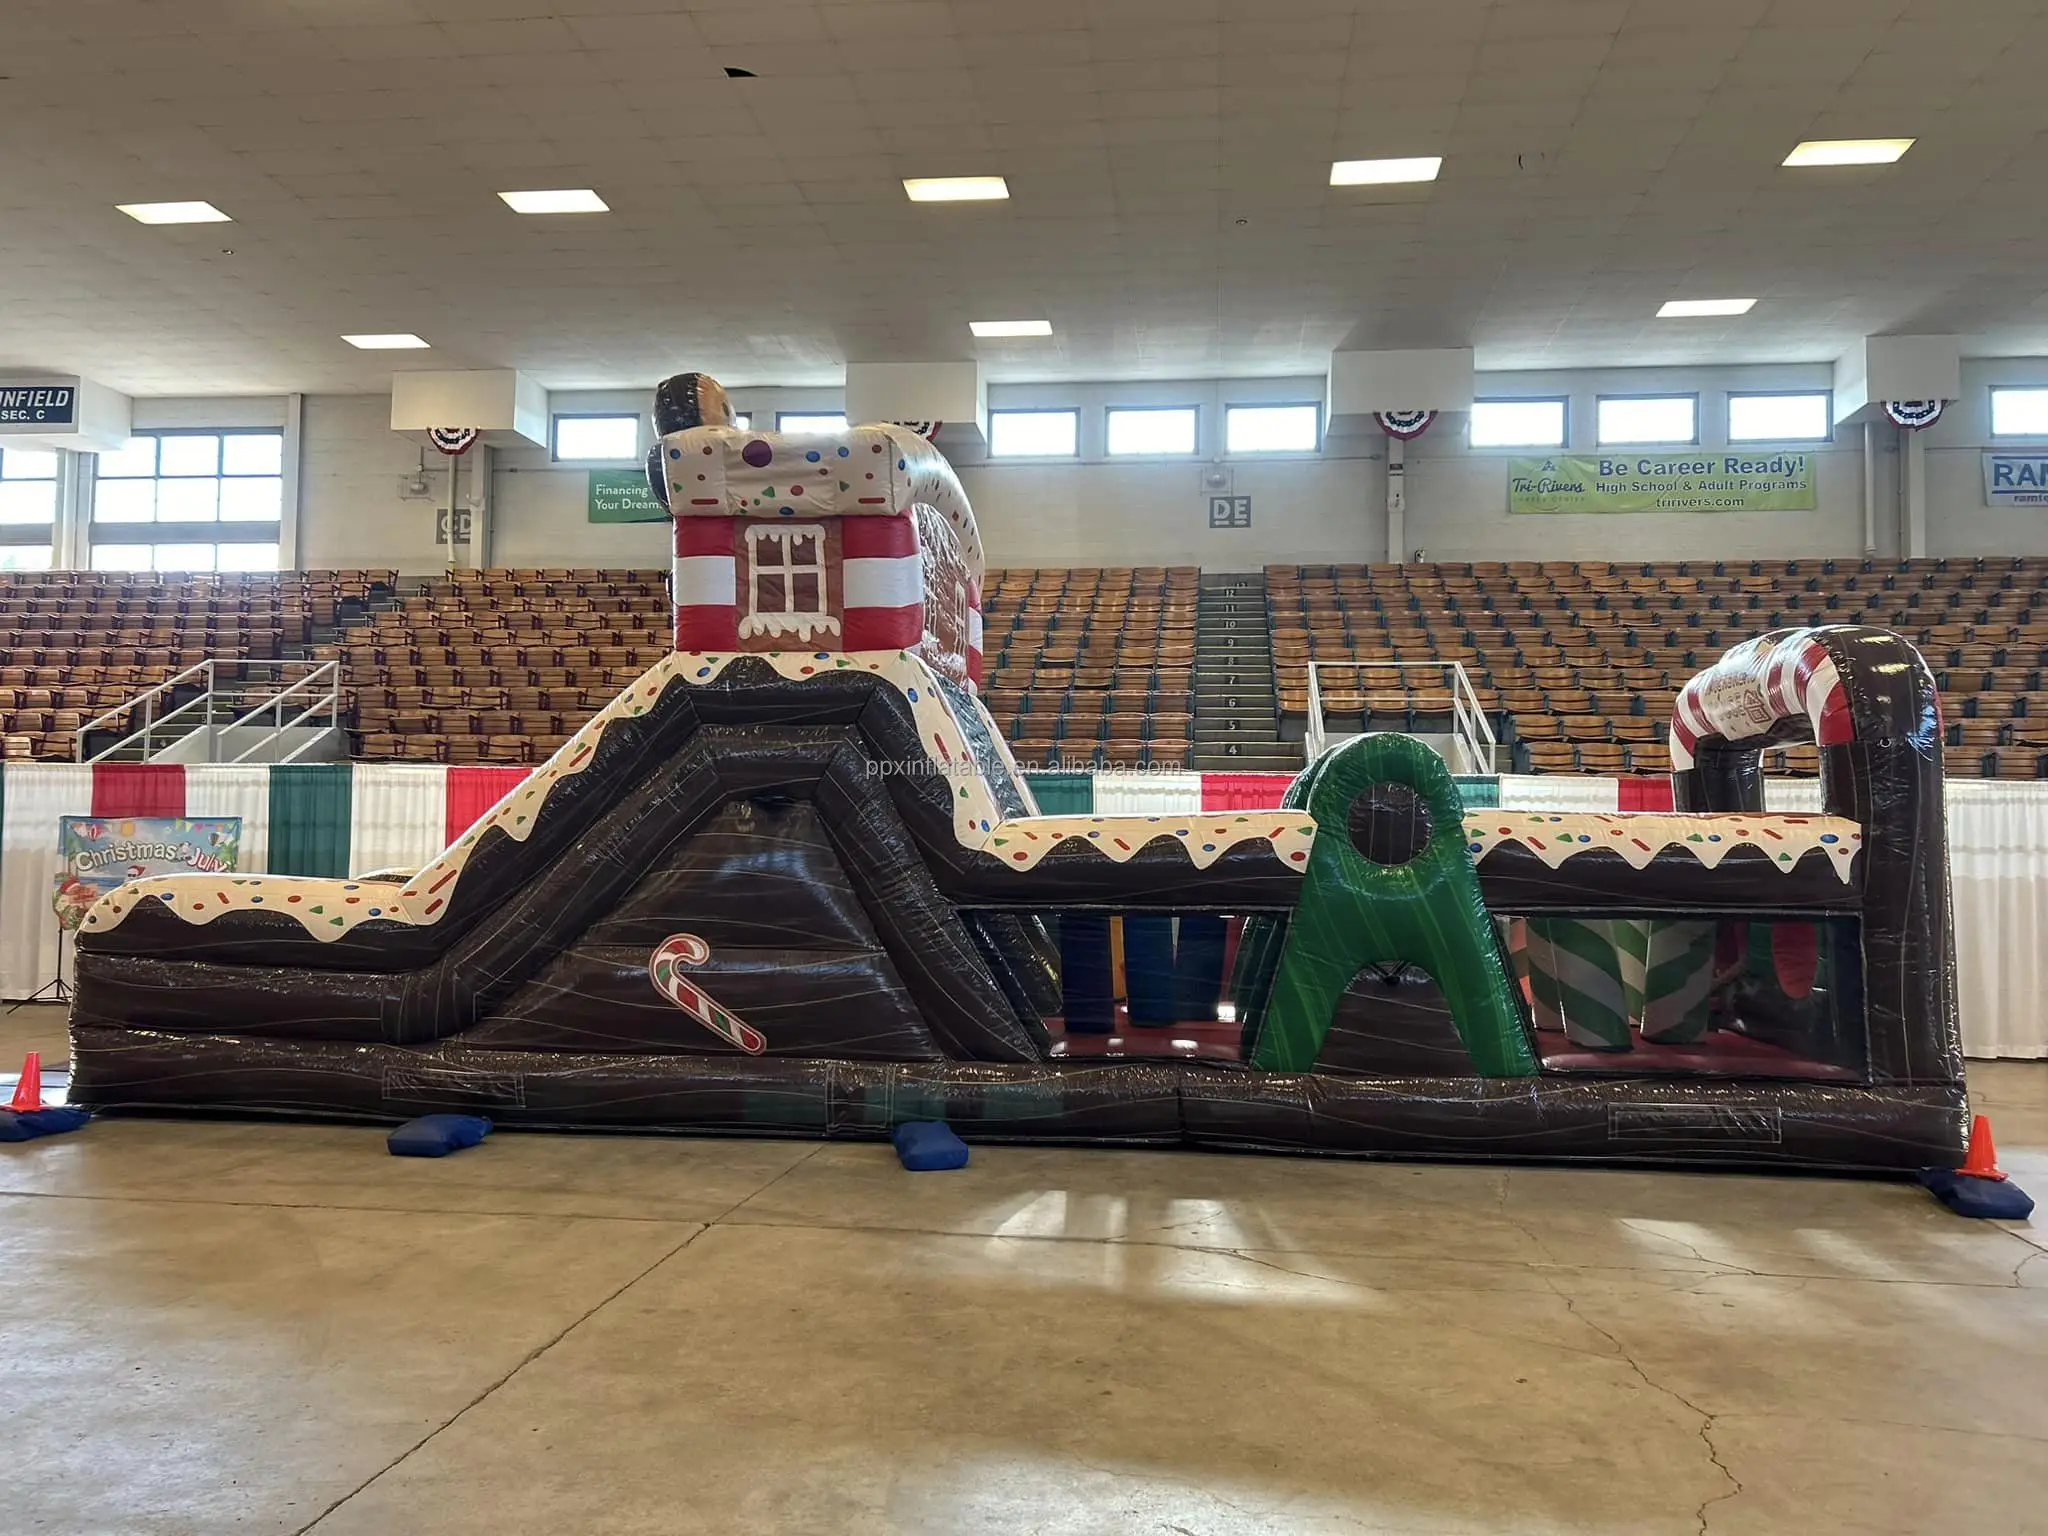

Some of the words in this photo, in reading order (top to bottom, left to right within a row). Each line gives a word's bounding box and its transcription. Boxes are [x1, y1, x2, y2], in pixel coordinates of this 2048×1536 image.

[1, 410, 30, 420] SEC.
[36, 410, 45, 420] C
[1600, 460, 1628, 476] Be
[1637, 459, 1715, 475] Career
[1724, 456, 1804, 477] Ready!
[595, 484, 649, 498] Financing
[1596, 482, 1626, 494] High
[1632, 481, 1677, 492] School
[1683, 481, 1692, 491] &
[1698, 480, 1734, 491] Adult
[1739, 480, 1807, 492] Programs
[595, 499, 619, 510] Your
[1656, 498, 1744, 508] tririvers.com
[1225, 621, 1236, 629] 10
[1227, 638, 1234, 647] 9
[1228, 698, 1237, 707] 6
[1229, 721, 1236, 730] 5
[1229, 745, 1238, 755] 4
[75, 840, 178, 871] Christmas
